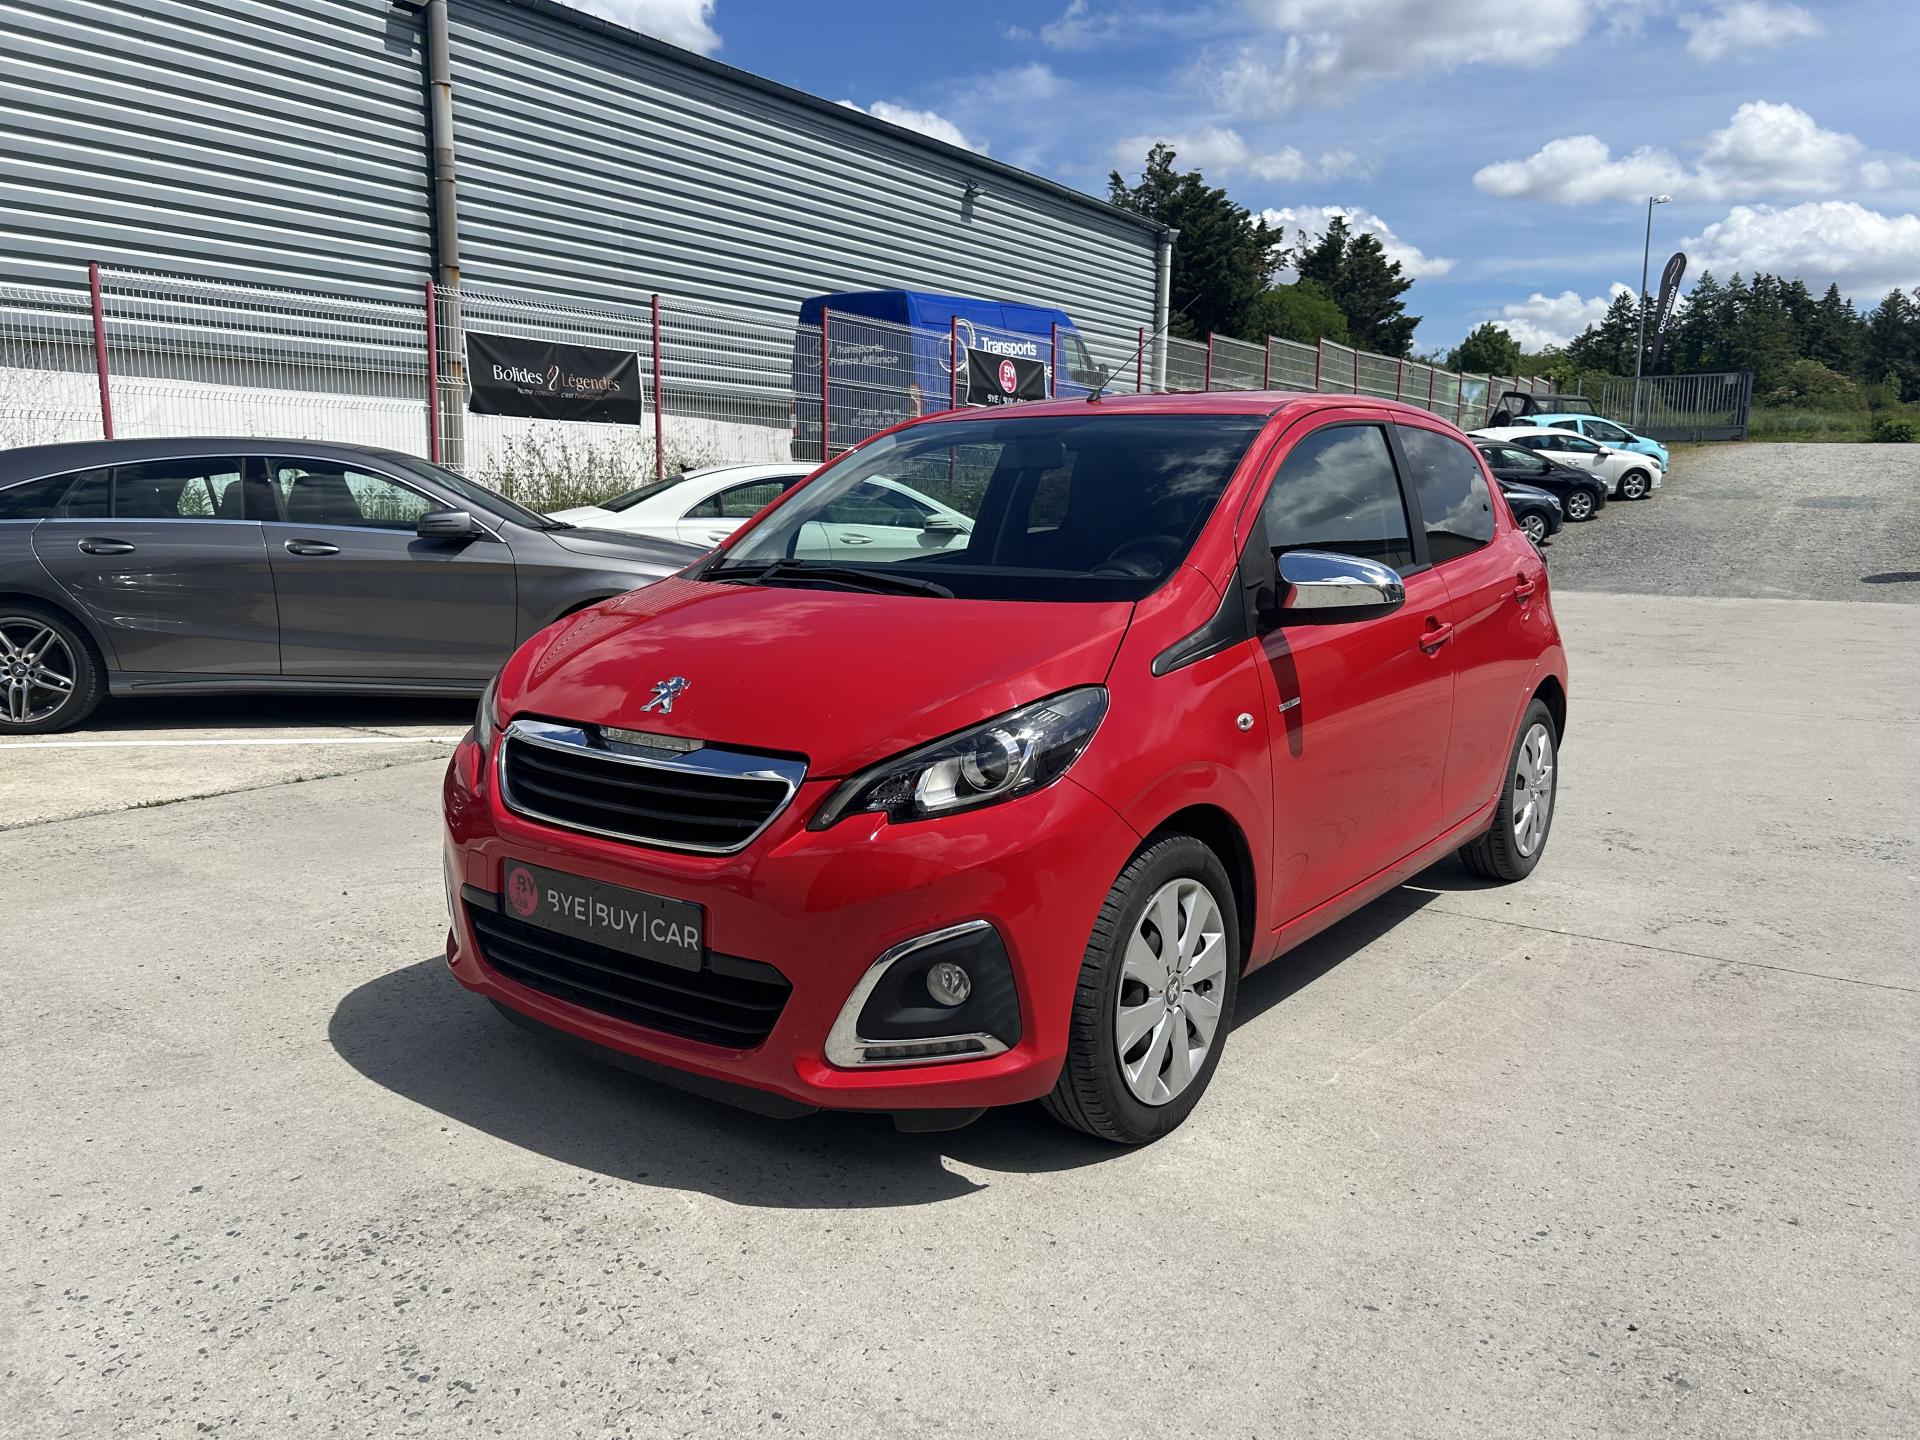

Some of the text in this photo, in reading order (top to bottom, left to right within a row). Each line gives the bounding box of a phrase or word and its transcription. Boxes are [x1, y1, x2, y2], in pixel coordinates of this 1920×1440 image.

[1658, 285, 1677, 334] OCCASION
[980, 337, 1037, 356] Transports
[492, 364, 620, 392] Bolides Légendes
